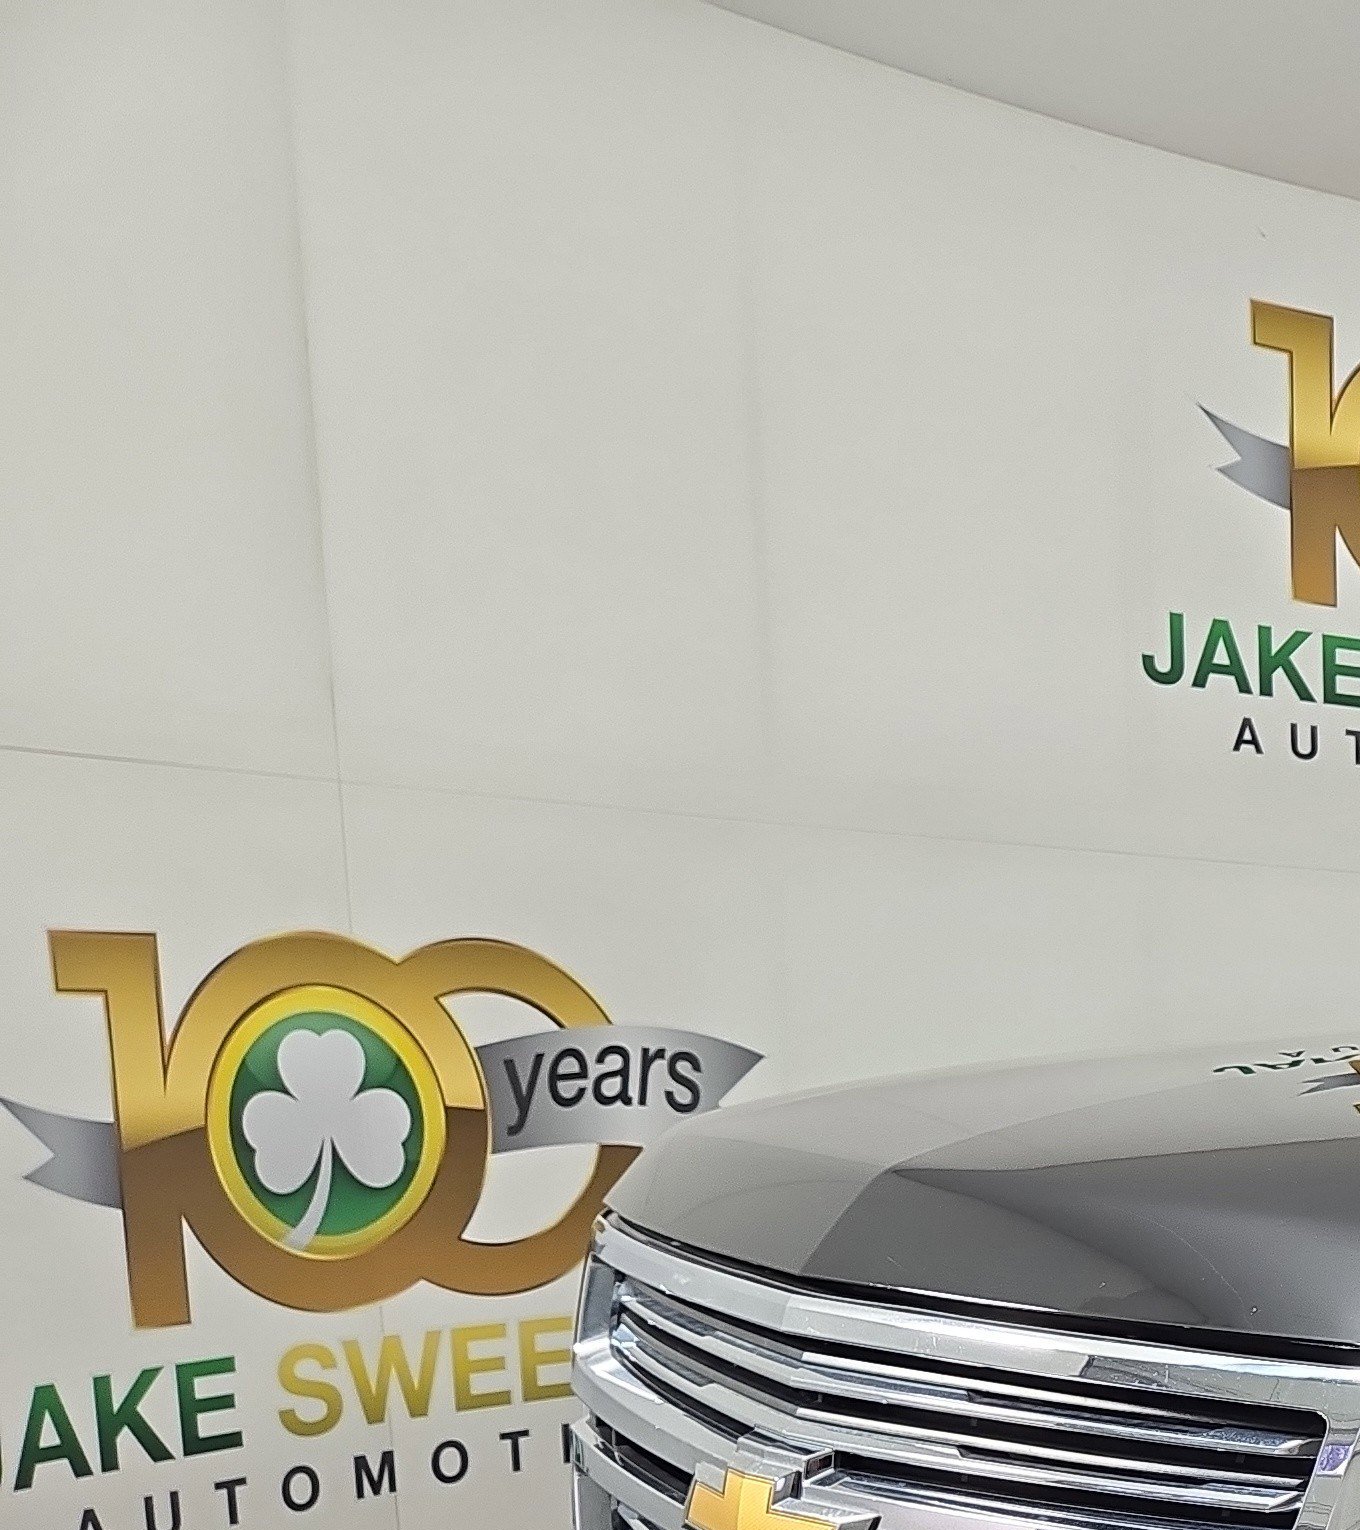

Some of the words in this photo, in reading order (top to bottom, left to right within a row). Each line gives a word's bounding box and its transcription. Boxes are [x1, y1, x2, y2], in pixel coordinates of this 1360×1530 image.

[47, 929, 642, 1330] 100
[502, 1039, 704, 1137] years
[0, 1355, 244, 1492] AKE
[277, 1316, 574, 1438] SWEE
